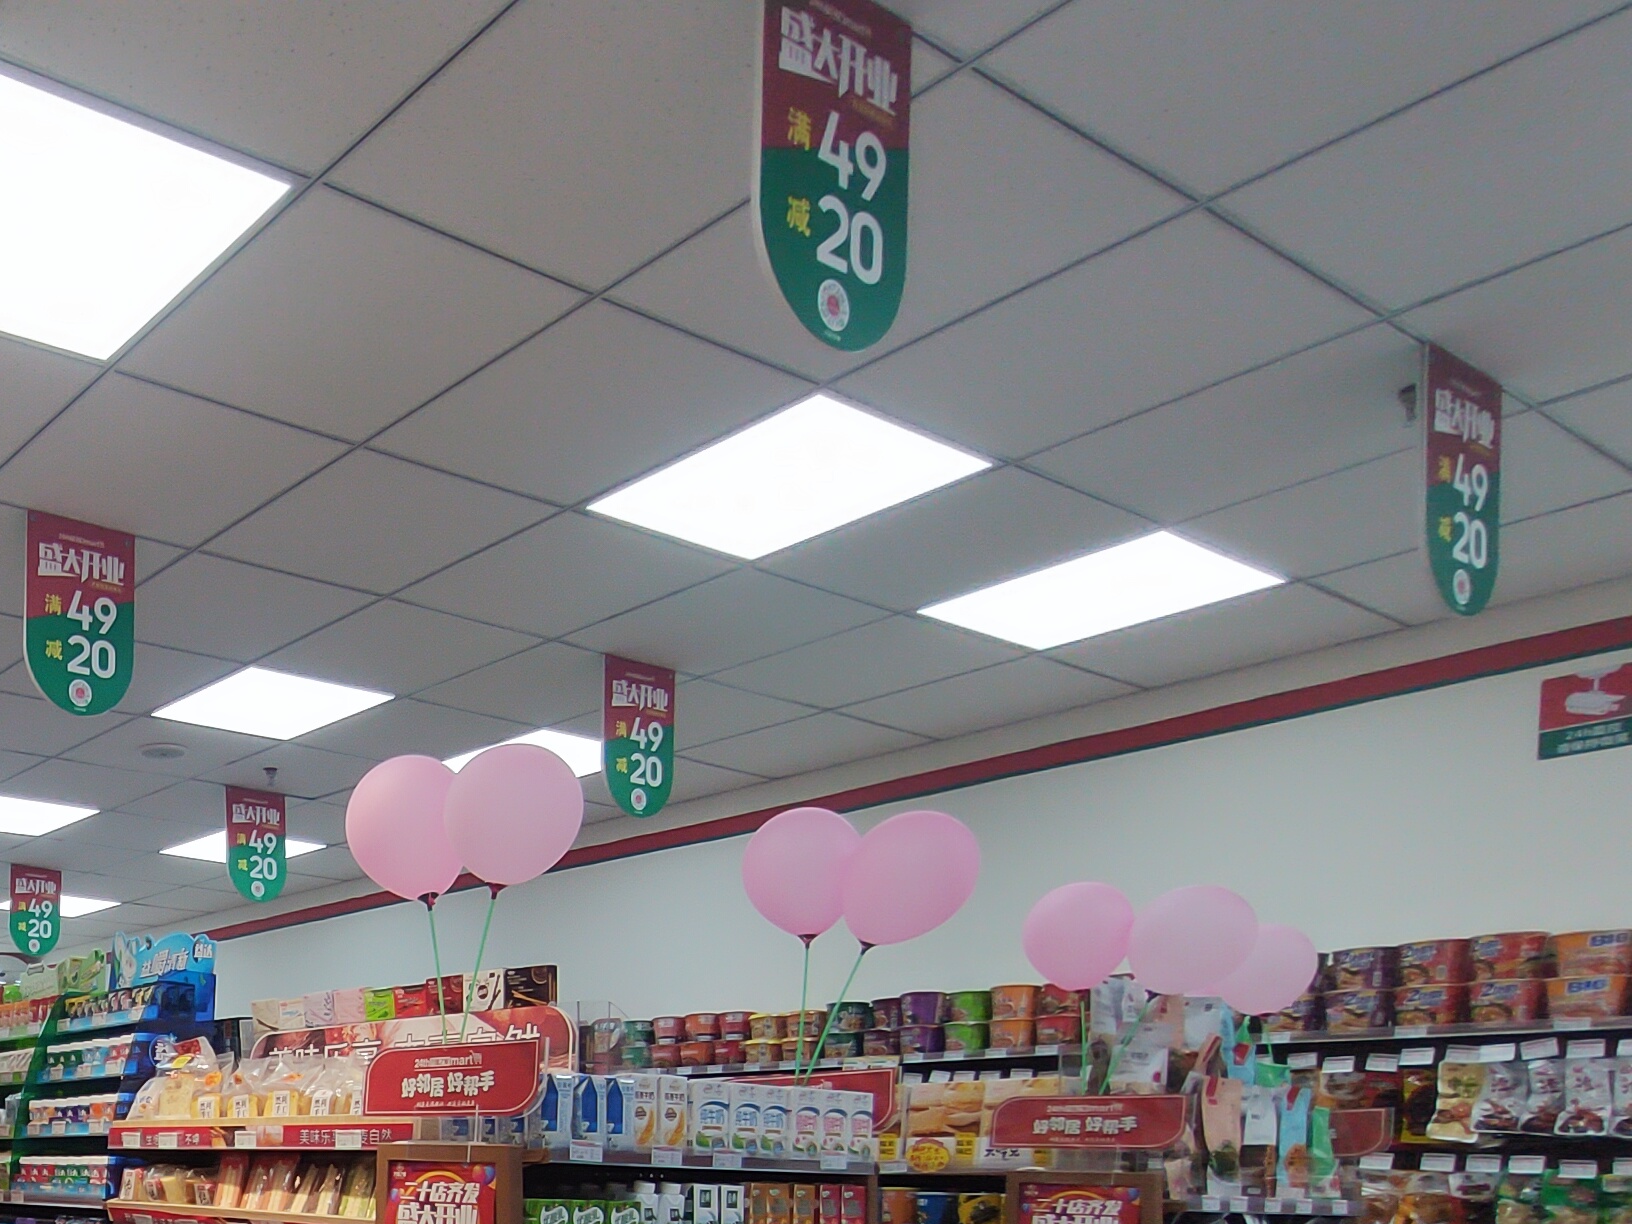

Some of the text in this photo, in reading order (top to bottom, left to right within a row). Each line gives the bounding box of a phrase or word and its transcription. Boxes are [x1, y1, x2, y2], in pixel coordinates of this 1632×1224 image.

[779, 5, 898, 116] 盛大开业
[818, 110, 887, 201] 49
[816, 194, 883, 284] 20
[1434, 388, 1494, 449] 盛大开业
[1453, 454, 1489, 512] 49
[1452, 511, 1487, 569] 20
[38, 542, 125, 586] 盛大开业
[67, 590, 117, 634] 49
[67, 635, 116, 679] 20
[611, 679, 668, 712] 盛大开业
[630, 717, 663, 752] 49
[630, 752, 662, 788] 20
[249, 829, 277, 854] 49
[249, 855, 277, 880] 20
[28, 898, 53, 918] 49
[28, 919, 52, 939] 20
[401, 1070, 496, 1098] 好邻居 好帮手
[399, 1180, 481, 1204] 二十店齐发
